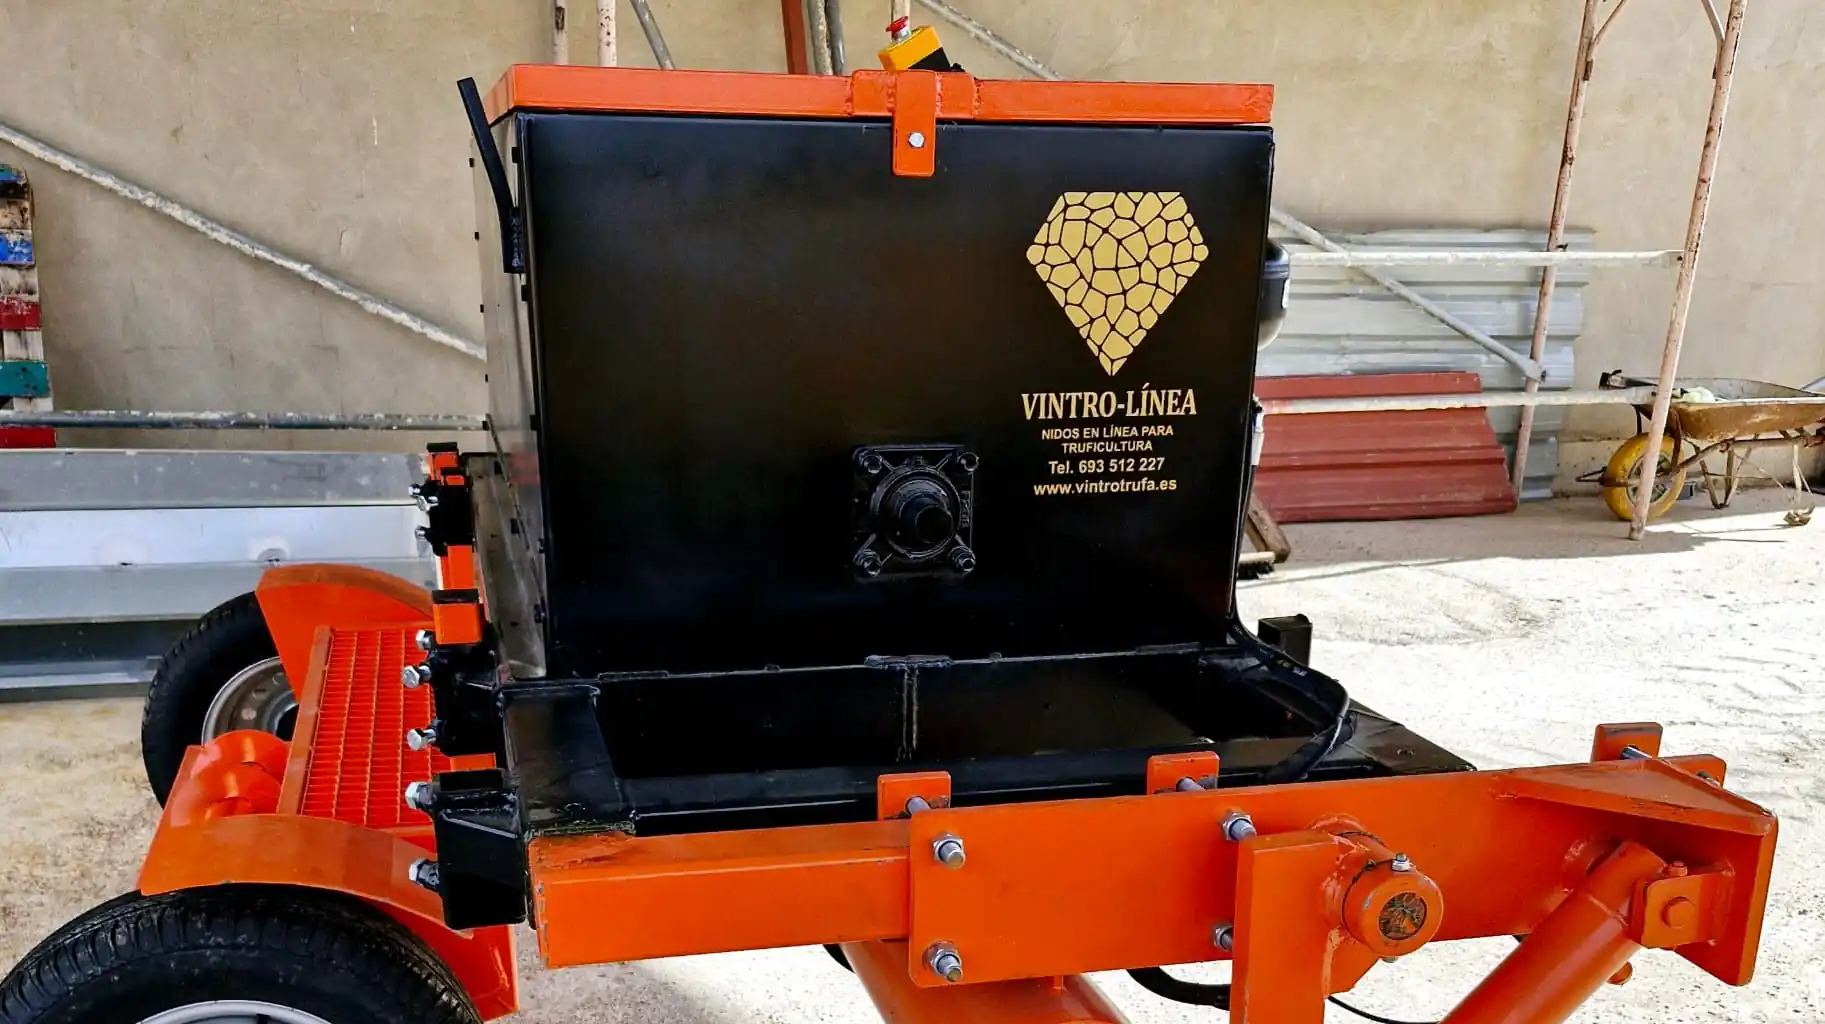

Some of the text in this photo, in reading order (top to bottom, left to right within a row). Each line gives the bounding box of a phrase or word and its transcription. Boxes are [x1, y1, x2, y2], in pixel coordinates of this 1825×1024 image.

[1021, 382, 1197, 420] VINTRO-LÍNEA
[1042, 424, 1174, 440] NIDOS EN LÍNEA PARA
[1062, 440, 1153, 454] TRUFICULTURA
[1048, 457, 1165, 475] Tel. 693 512 227
[1034, 477, 1177, 496] www.vintrotrufa.es
